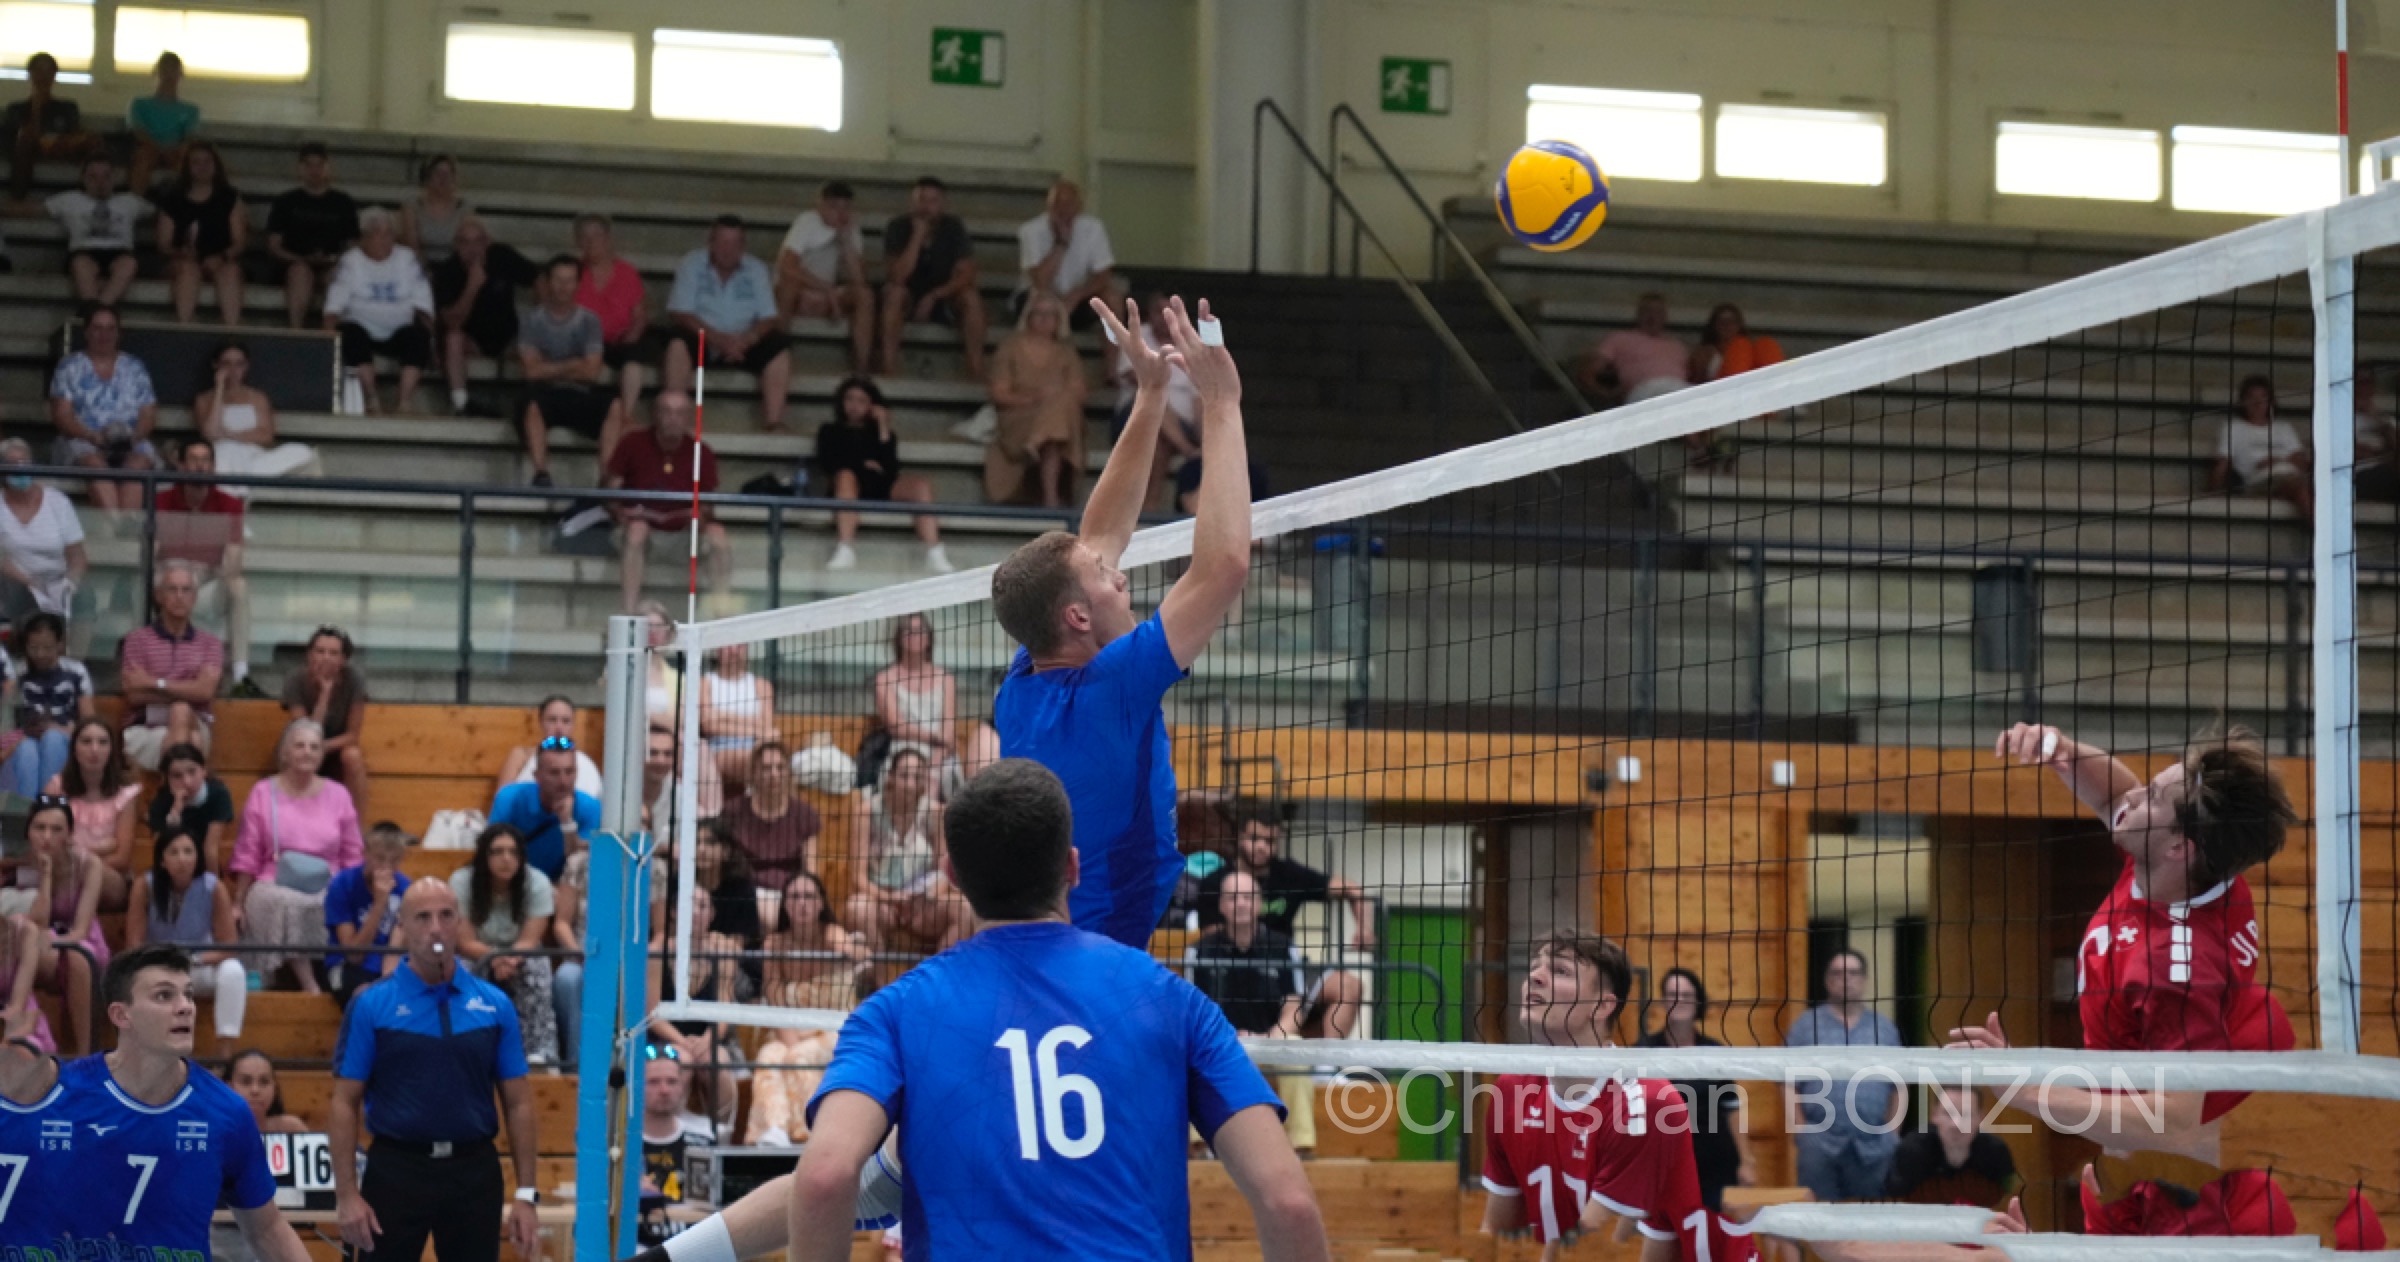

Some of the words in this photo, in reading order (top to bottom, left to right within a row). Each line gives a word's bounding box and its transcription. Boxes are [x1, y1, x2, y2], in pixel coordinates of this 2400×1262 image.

[994, 1024, 1106, 1161] 16
[40, 1139, 72, 1151] ISR
[176, 1139, 207, 1152] ISR
[298, 1143, 332, 1185] 16
[0, 1154, 29, 1224] 7
[123, 1154, 159, 1225] 7
